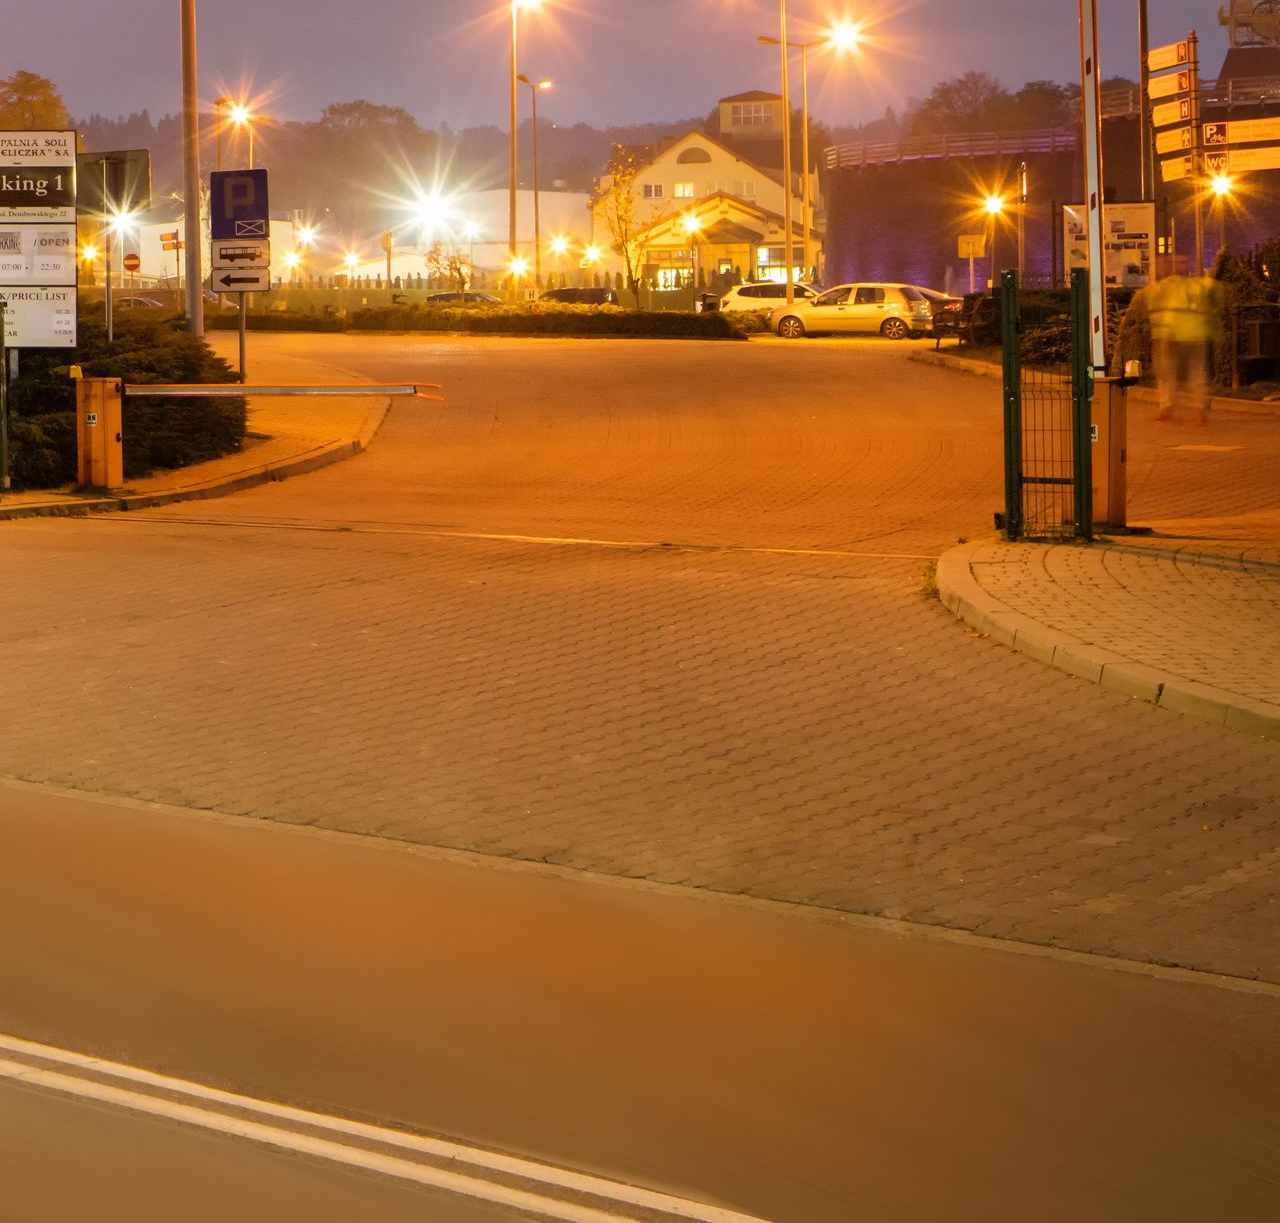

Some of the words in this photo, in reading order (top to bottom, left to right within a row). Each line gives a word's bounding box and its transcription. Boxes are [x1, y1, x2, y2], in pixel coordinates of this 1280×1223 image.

[1206, 125, 1217, 138] P
[44, 139, 67, 147] SOLI
[1207, 157, 1227, 168] WC
[53, 174, 64, 191] 1
[224, 177, 255, 218] P
[45, 292, 68, 301] LIST
